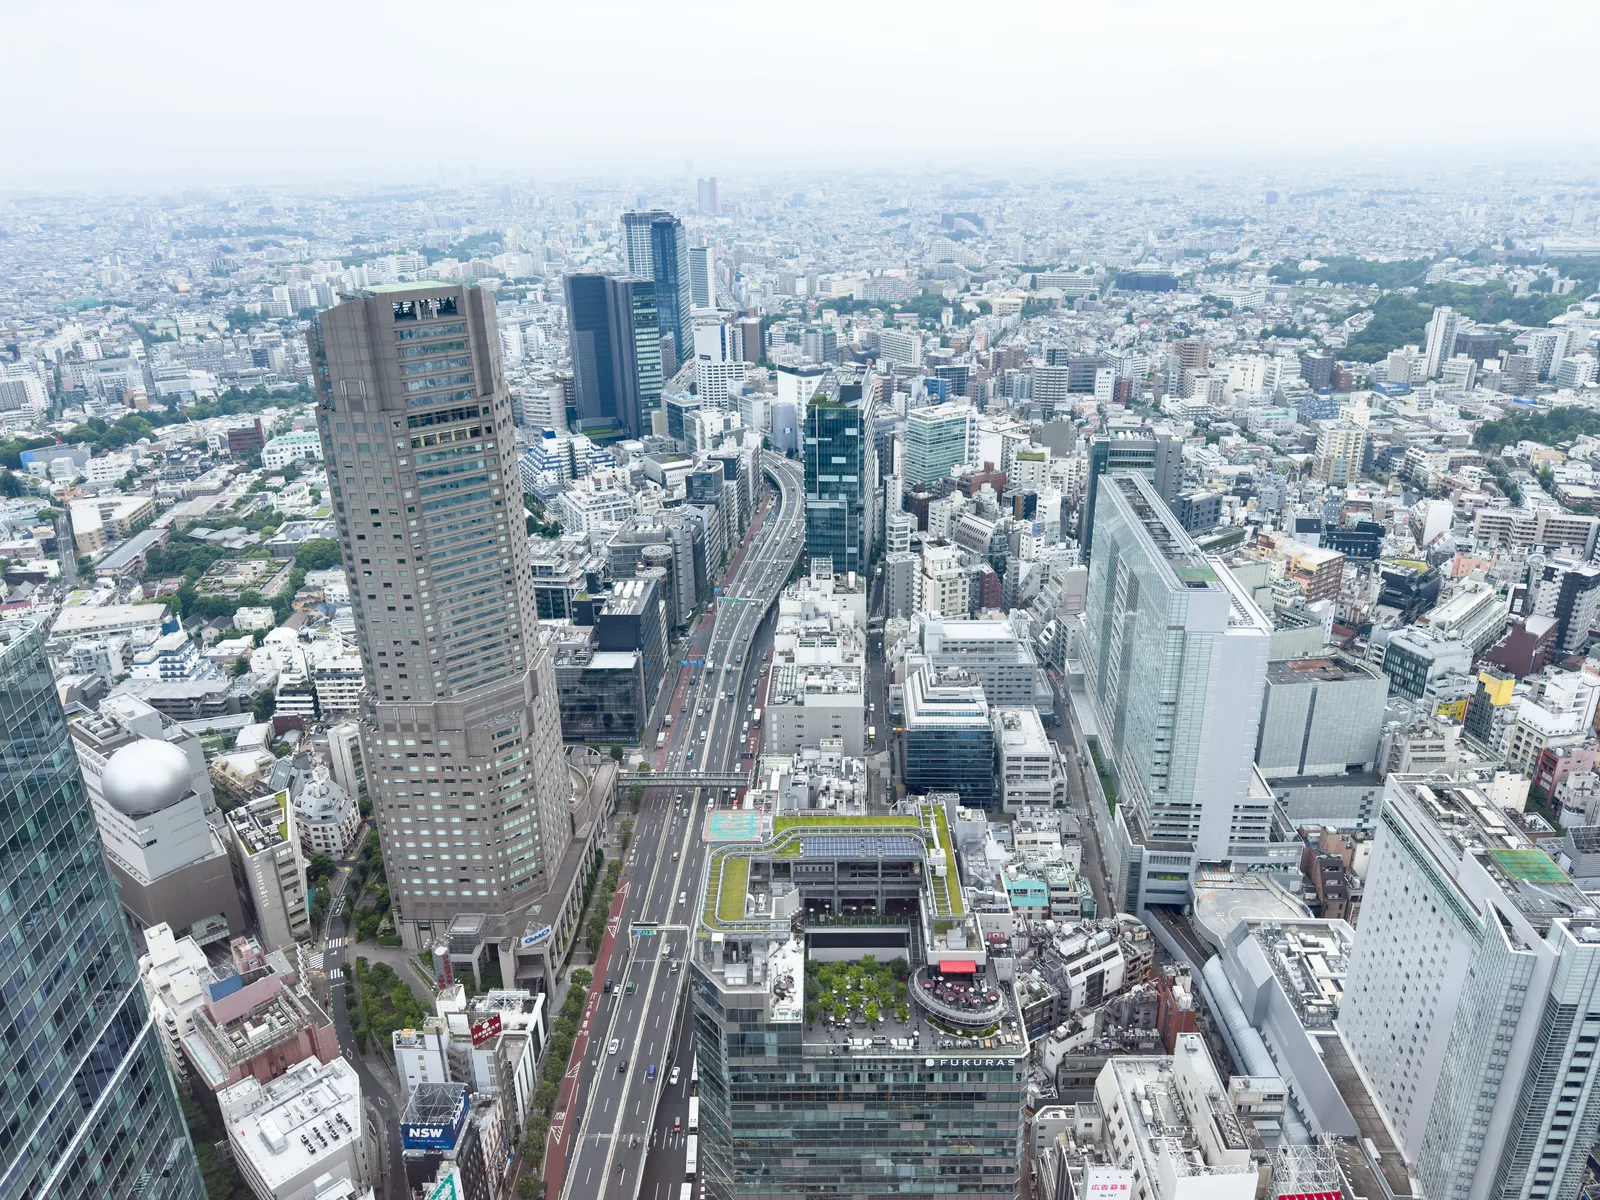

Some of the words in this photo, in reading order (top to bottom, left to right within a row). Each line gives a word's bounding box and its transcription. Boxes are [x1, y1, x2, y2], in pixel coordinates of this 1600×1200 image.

[524, 929, 550, 943] GMO
[408, 1128, 443, 1138] NSW
[1091, 1183, 1128, 1191] 広告募集
